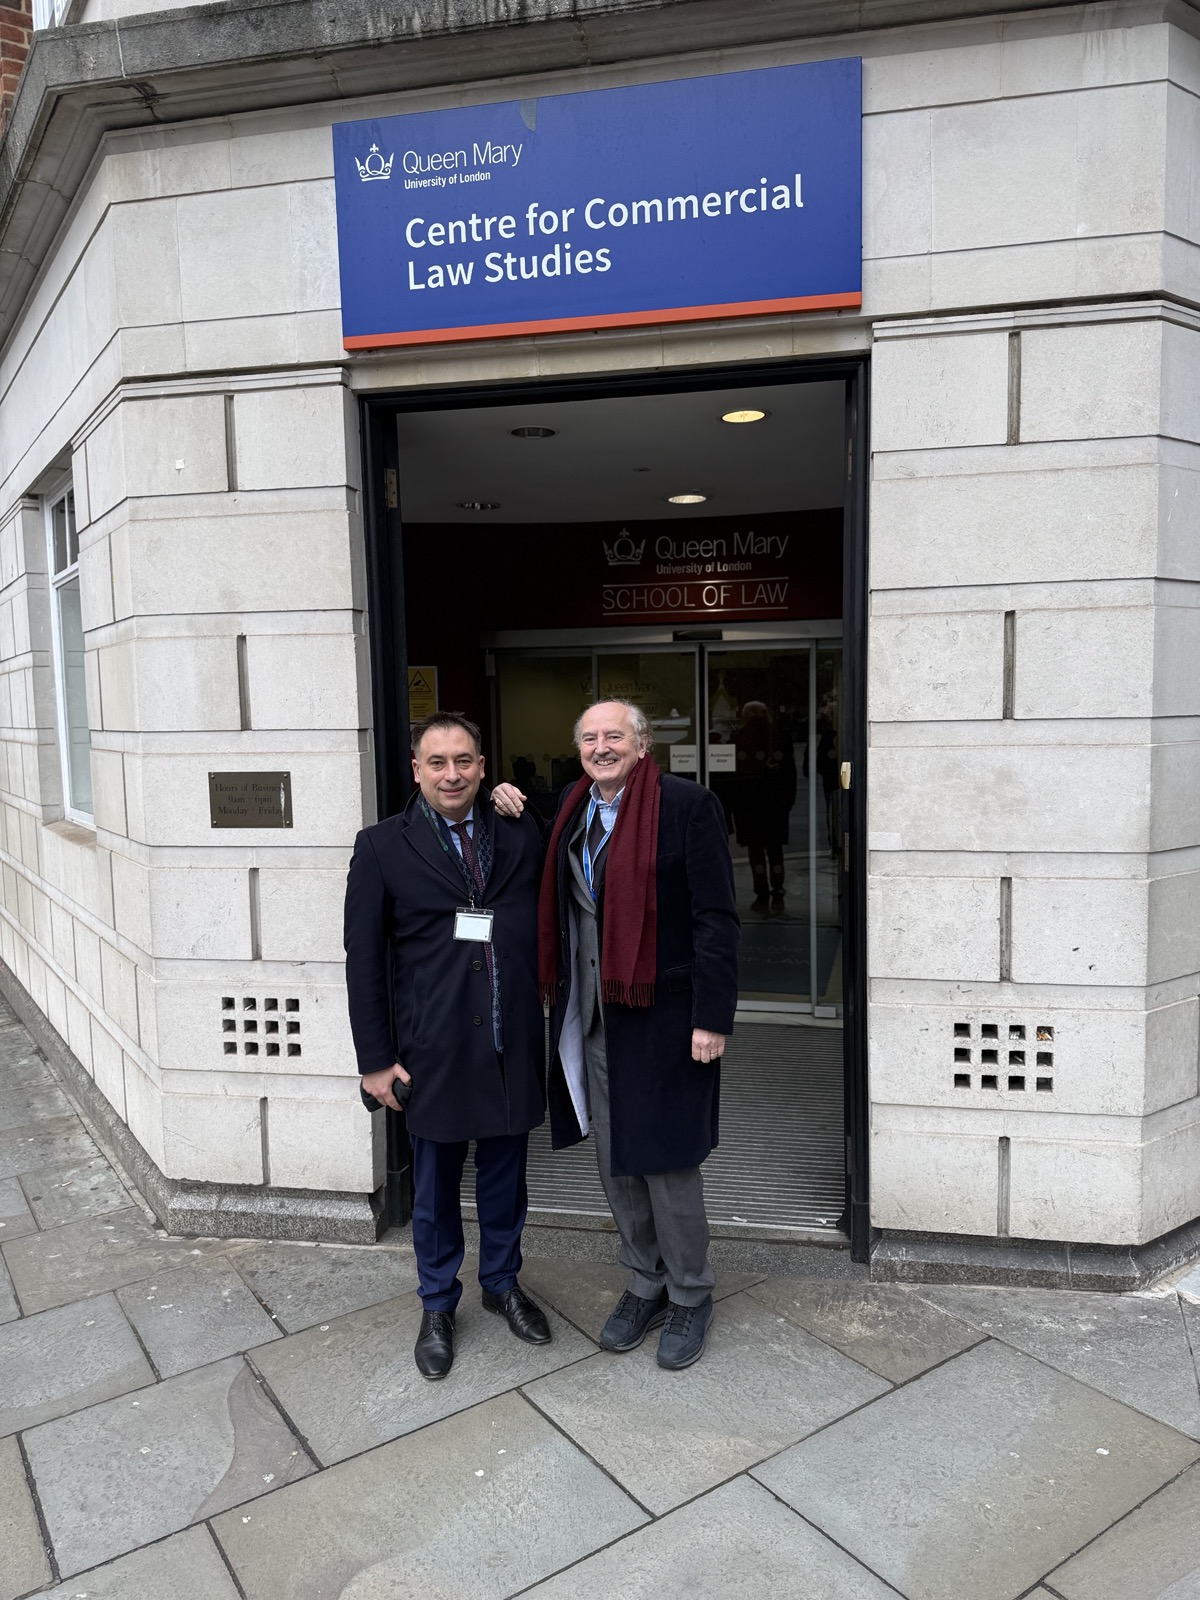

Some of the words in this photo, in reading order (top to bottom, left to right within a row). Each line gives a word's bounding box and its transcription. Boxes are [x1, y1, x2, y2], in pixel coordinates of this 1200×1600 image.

[402, 150, 467, 174] Queen
[473, 141, 523, 167] Mary
[404, 176, 447, 190] University
[448, 174, 458, 186] of
[459, 171, 491, 184] London
[405, 217, 517, 249] Centre
[525, 202, 576, 236] for
[584, 173, 804, 230] Commercial
[408, 260, 475, 291] Law
[484, 242, 612, 284] Studies
[655, 535, 726, 560] Queen
[733, 531, 789, 558] Mary
[656, 564, 703, 575] University
[705, 562, 715, 573] of
[717, 561, 752, 573] London
[602, 587, 696, 610] SCHOOL
[702, 584, 733, 607] OF
[741, 582, 789, 605] LAW
[218, 806, 248, 817] Monday
[258, 806, 283, 817] Friday
[228, 795, 245, 803] 9am
